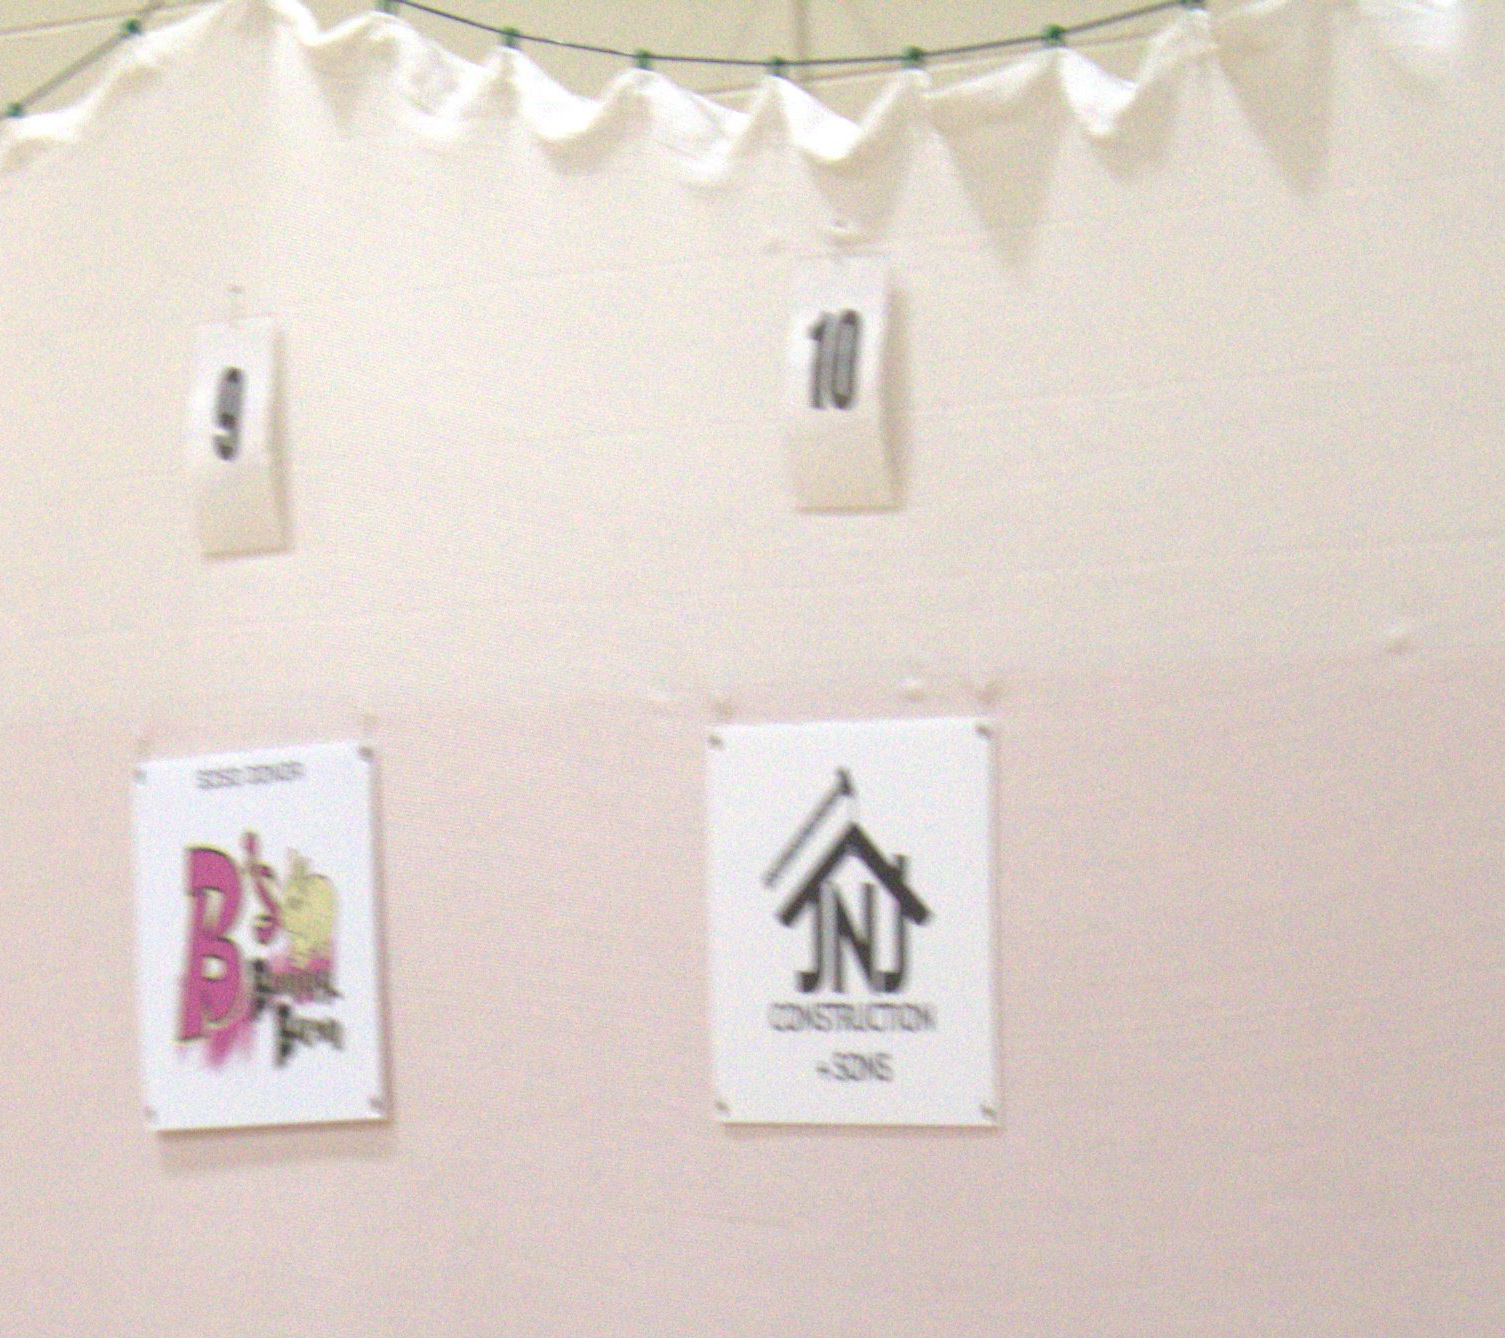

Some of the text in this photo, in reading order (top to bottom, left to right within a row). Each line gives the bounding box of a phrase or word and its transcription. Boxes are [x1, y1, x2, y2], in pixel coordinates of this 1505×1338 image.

[808, 309, 861, 410] 10
[212, 366, 245, 461] 9
[767, 1002, 937, 1032] CONSTRUCTION
